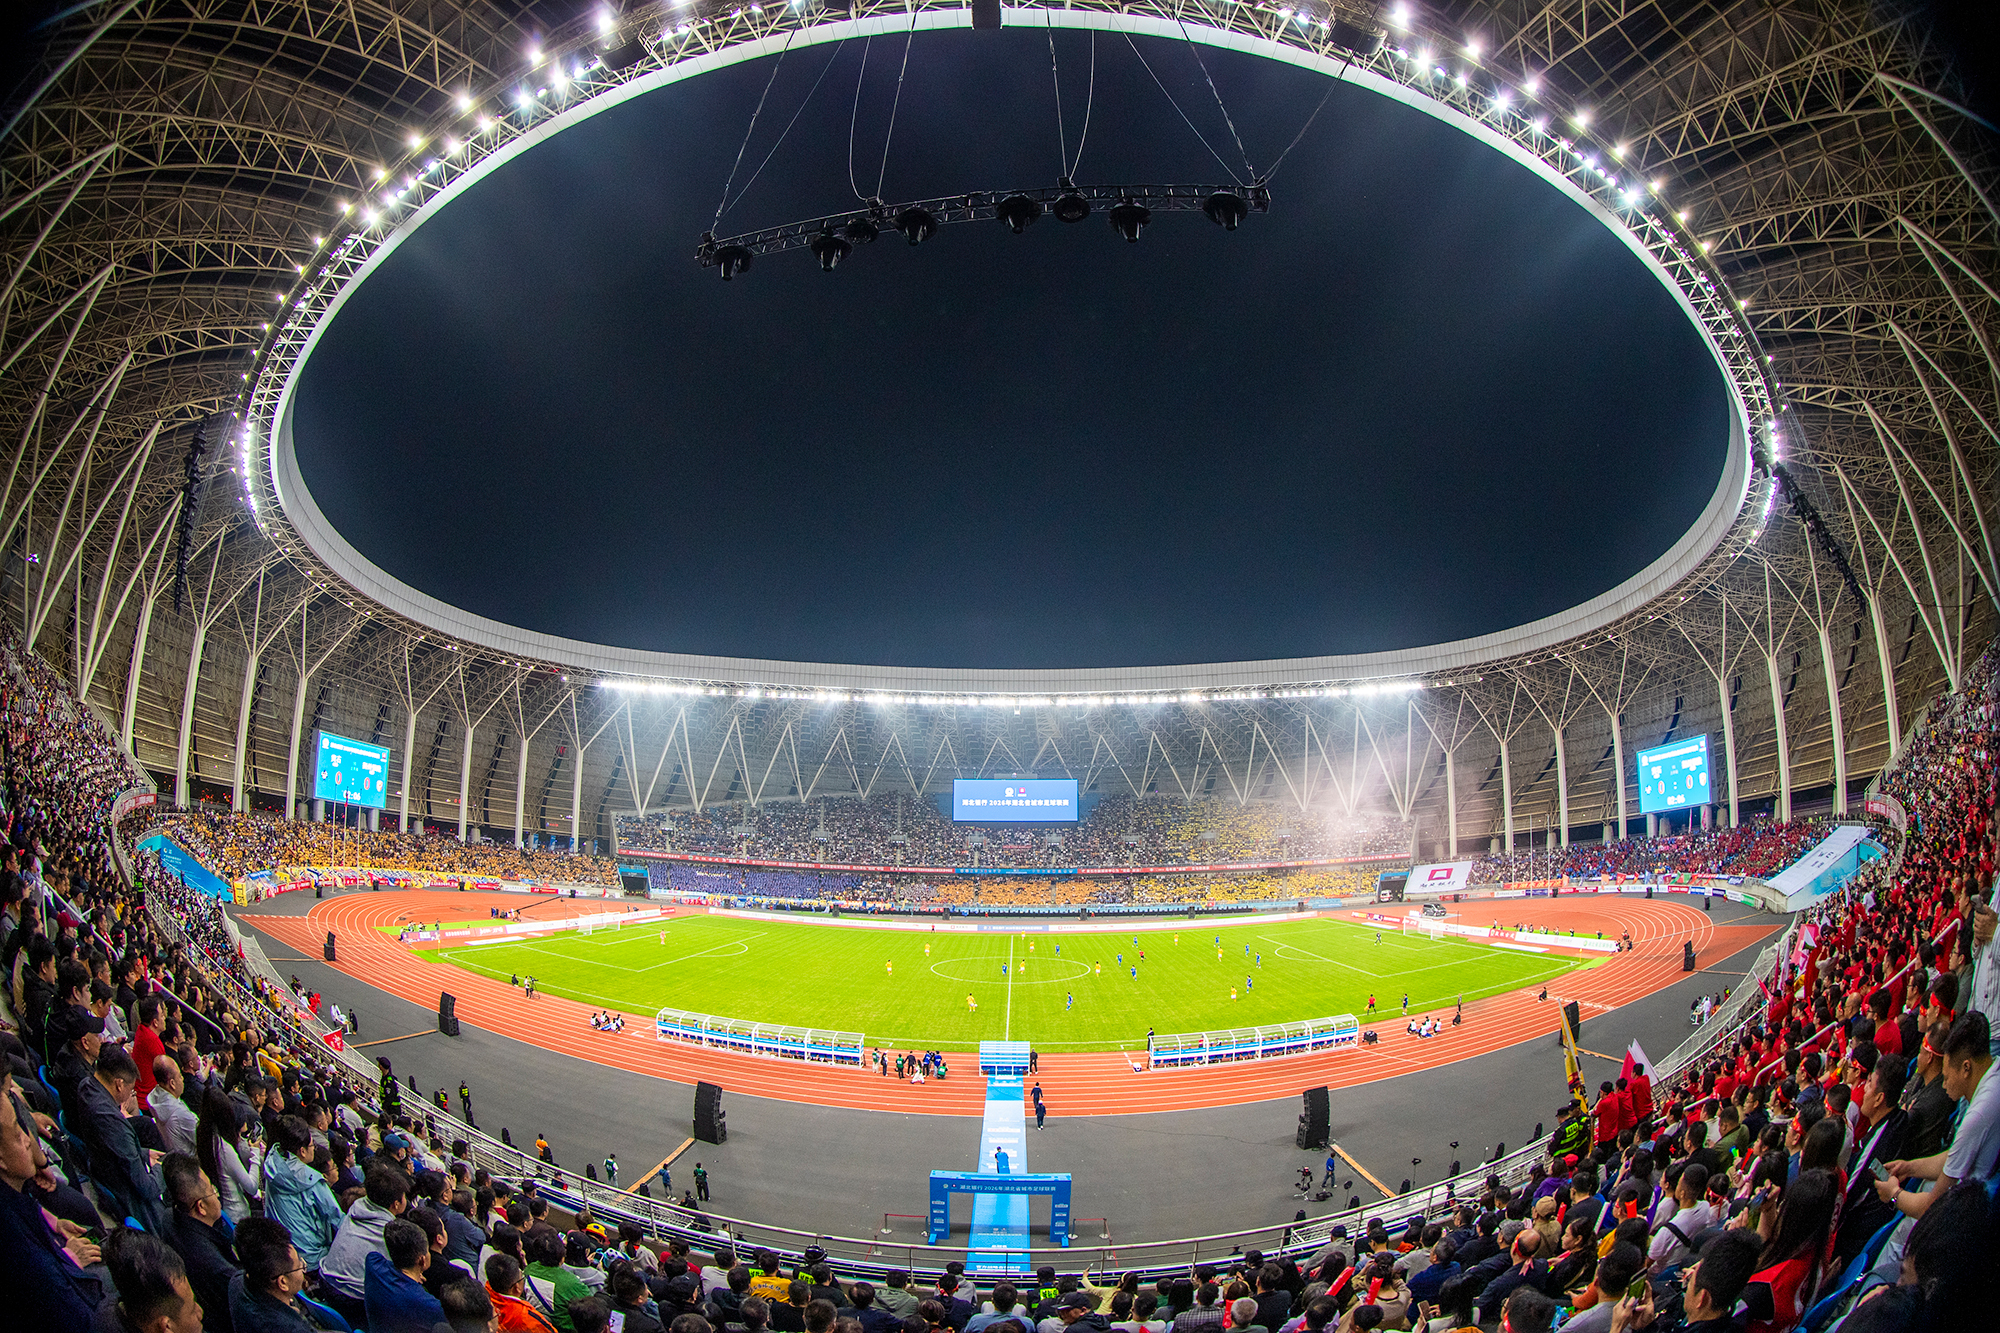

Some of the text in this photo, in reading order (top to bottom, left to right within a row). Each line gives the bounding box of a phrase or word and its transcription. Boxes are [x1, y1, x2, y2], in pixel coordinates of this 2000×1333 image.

[335, 771, 342, 785] 0
[364, 777, 370, 790] 0
[1658, 780, 1665, 794] 0
[1686, 775, 1693, 789] 0
[343, 790, 361, 801] 02:06
